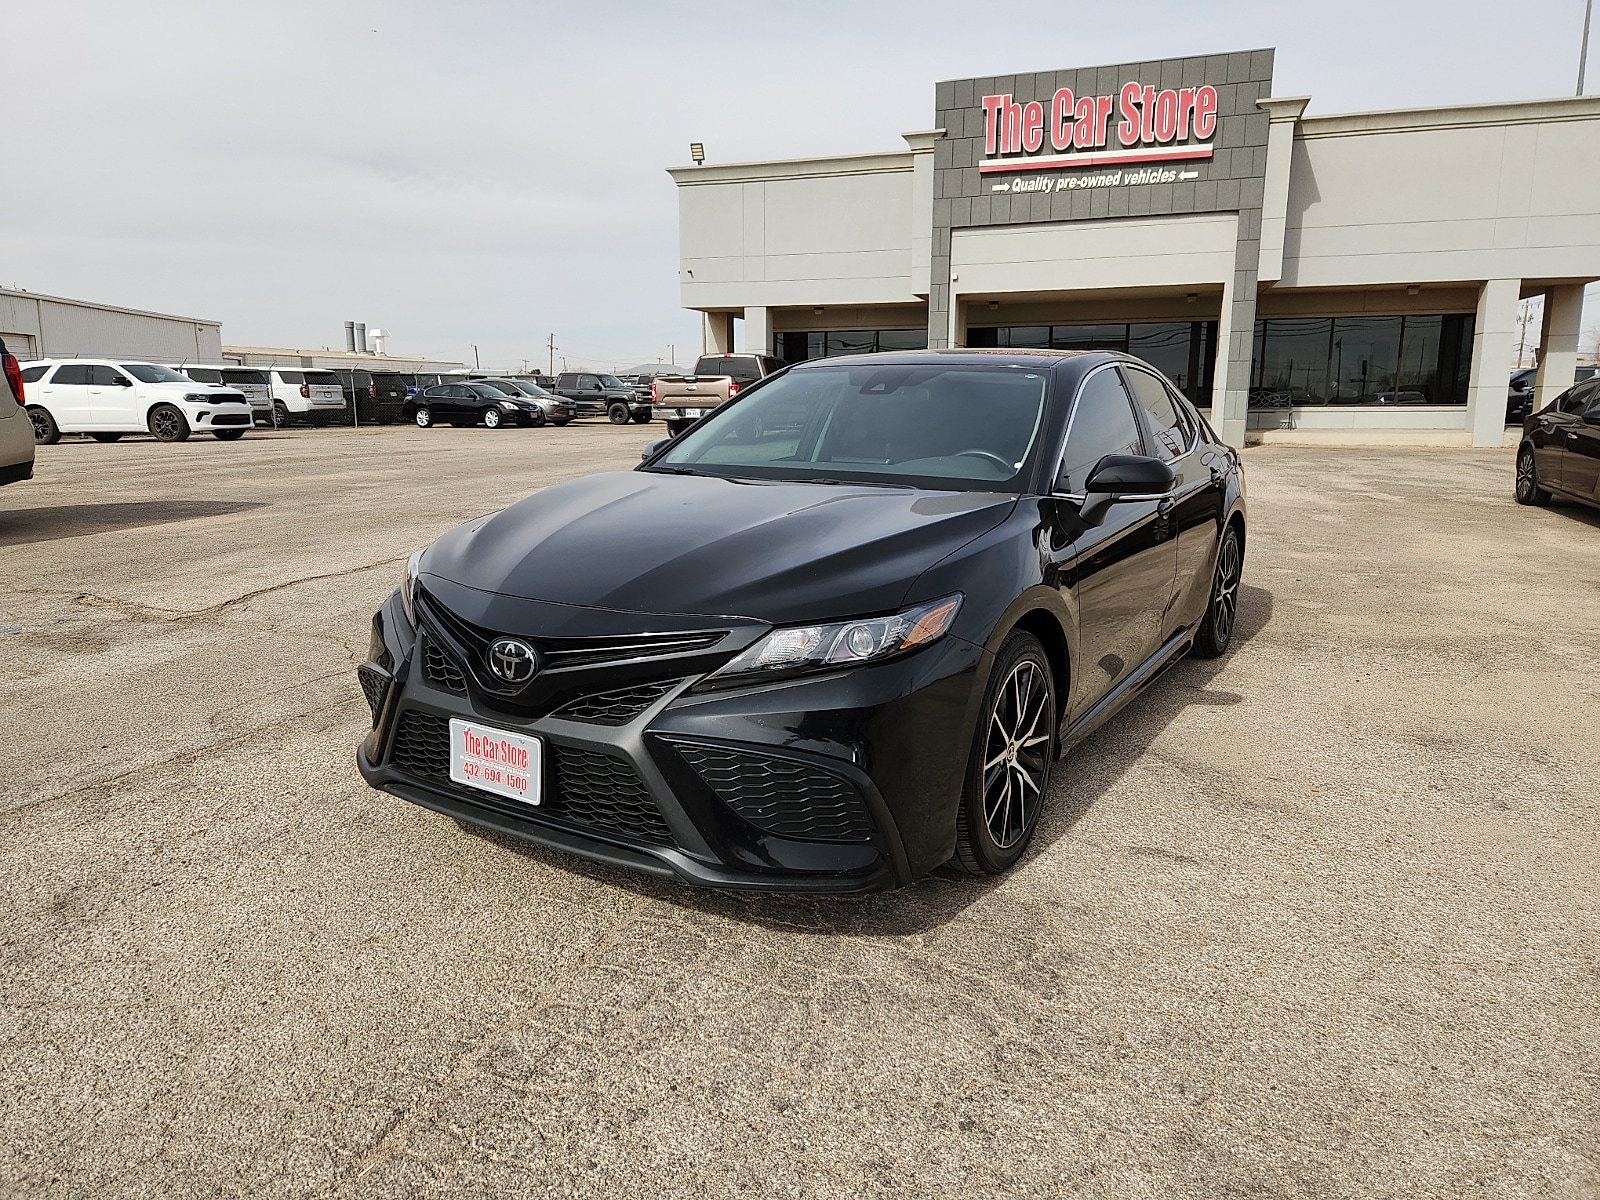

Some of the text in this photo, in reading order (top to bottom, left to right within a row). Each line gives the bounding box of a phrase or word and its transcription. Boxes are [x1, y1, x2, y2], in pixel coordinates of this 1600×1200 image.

[982, 81, 1217, 155] The Car Store
[1012, 169, 1177, 194] Quality pre-owned vehicles
[463, 730, 481, 755] The
[482, 735, 499, 761] Car
[500, 740, 528, 769] Store
